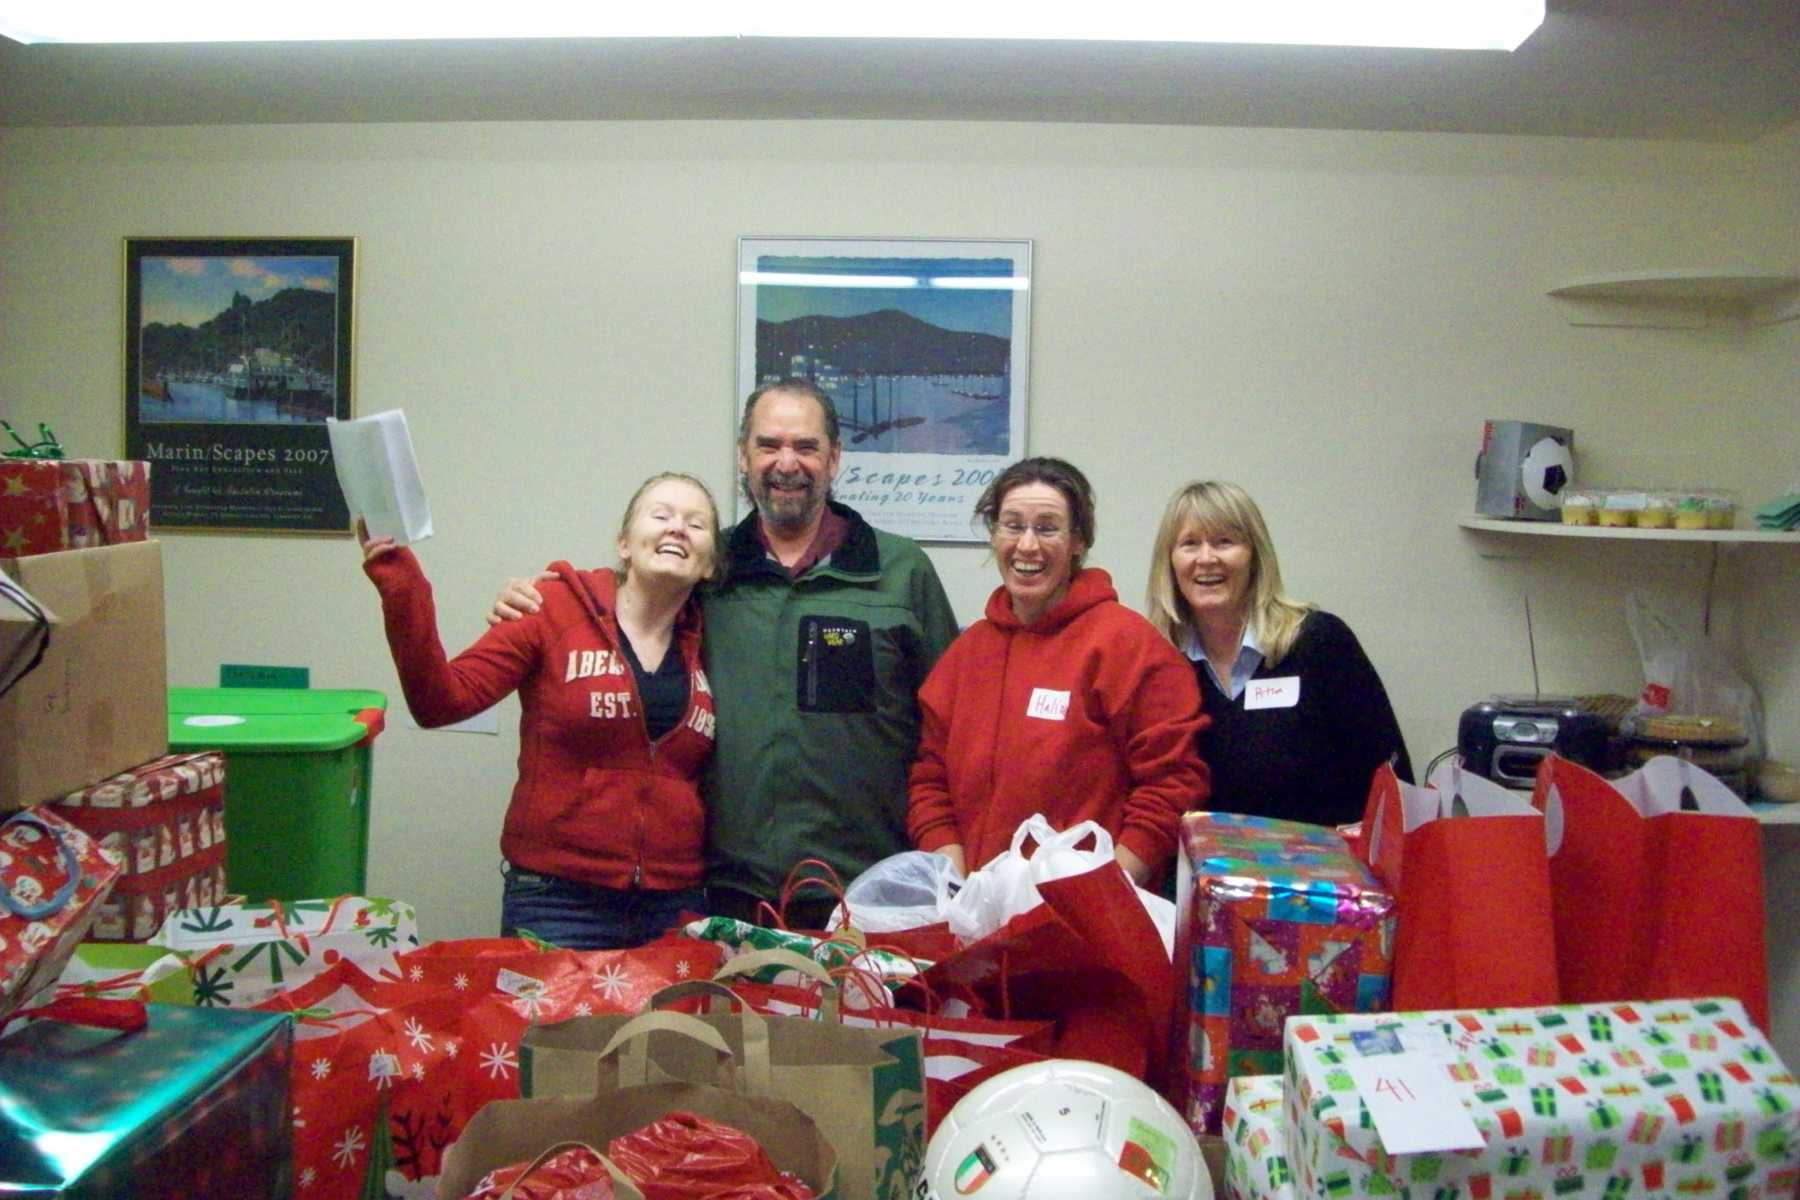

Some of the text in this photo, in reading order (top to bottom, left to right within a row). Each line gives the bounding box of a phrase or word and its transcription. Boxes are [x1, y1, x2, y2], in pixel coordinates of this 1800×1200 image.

[147, 443, 330, 466] Marin/Scapes 2007
[952, 467, 1003, 487] 200
[918, 490, 966, 505] Years
[590, 691, 638, 719] EST.
[1376, 1077, 1417, 1104] 41
